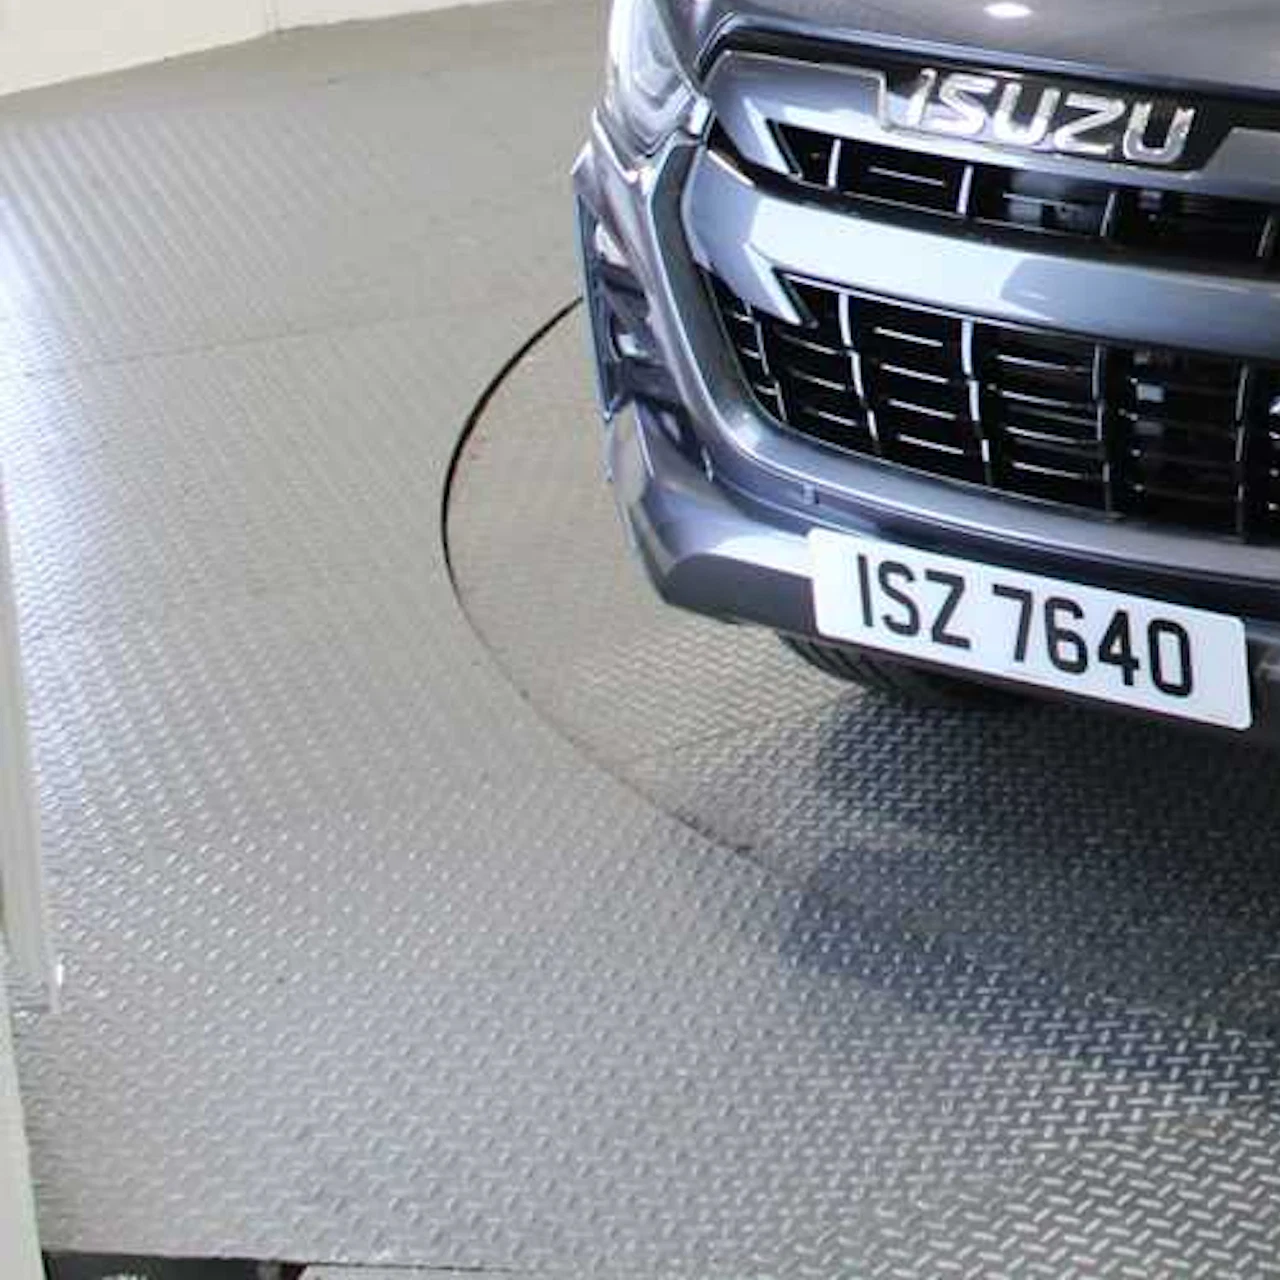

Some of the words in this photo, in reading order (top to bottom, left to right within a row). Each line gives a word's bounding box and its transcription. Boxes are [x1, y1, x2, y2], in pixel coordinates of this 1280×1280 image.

[903, 67, 1196, 164] ISUZU
[855, 553, 972, 651] ISZ
[991, 582, 1195, 698] 7640
